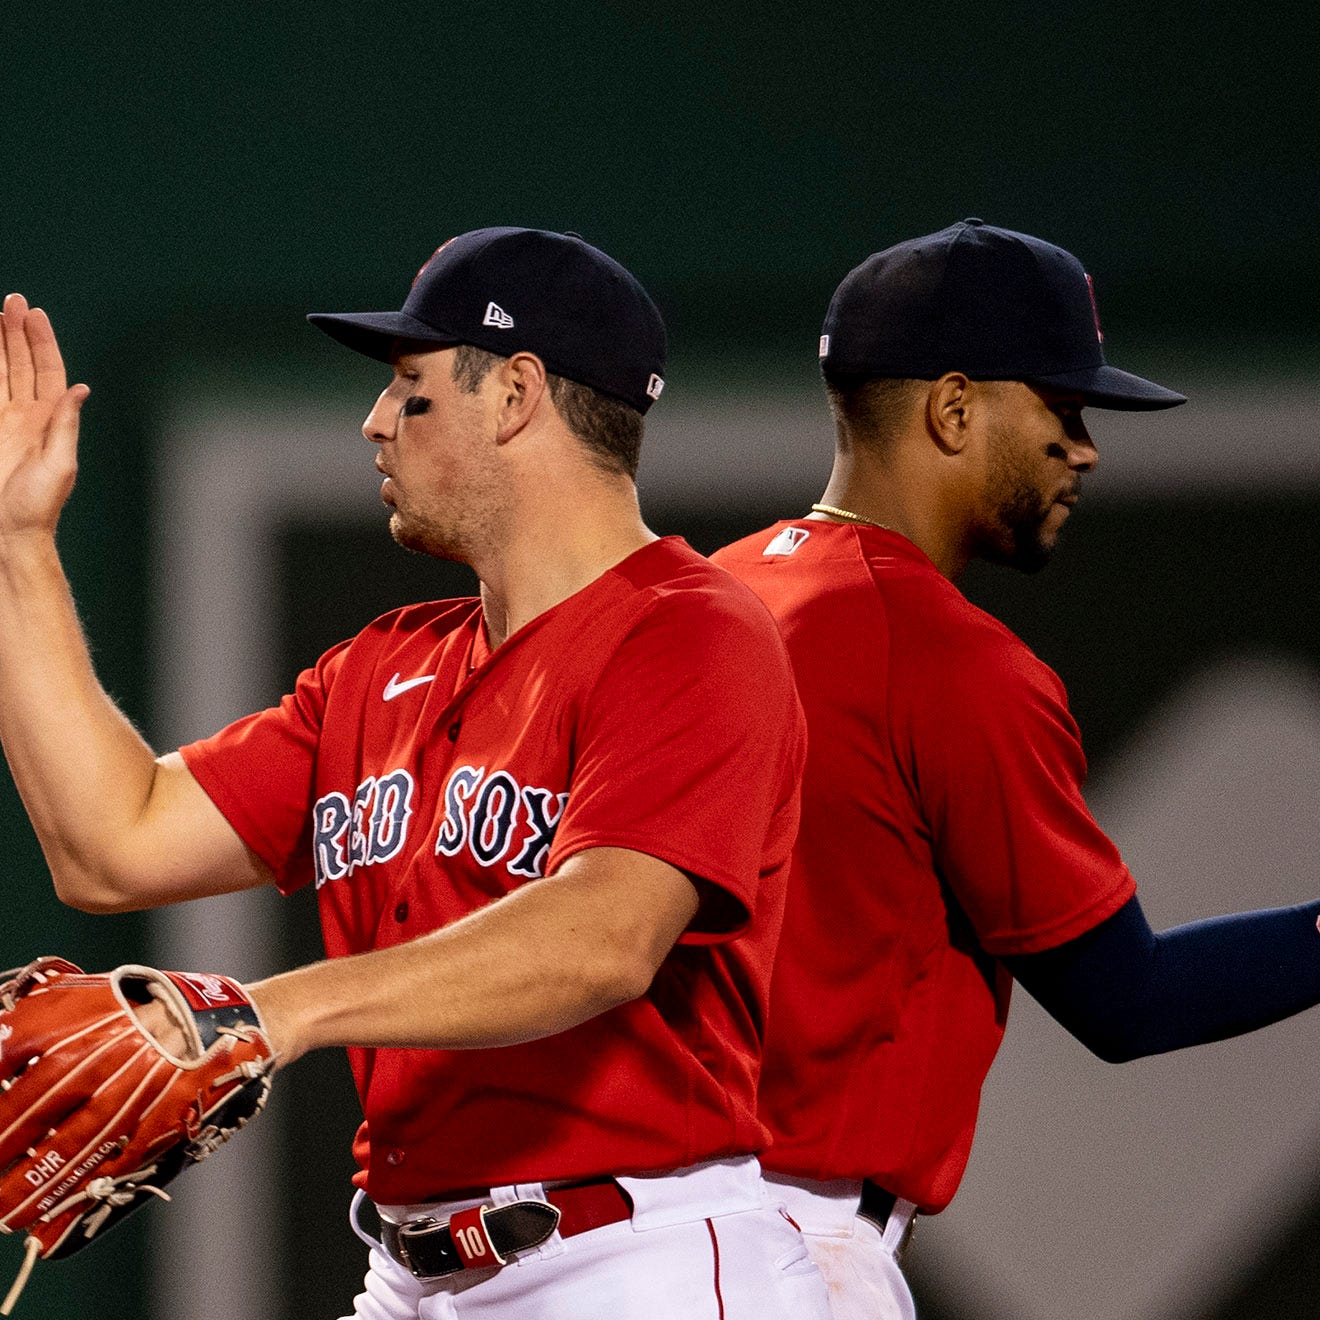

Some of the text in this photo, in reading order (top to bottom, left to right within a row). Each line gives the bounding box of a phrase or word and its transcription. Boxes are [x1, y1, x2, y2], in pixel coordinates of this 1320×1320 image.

[313, 766, 570, 889] RED SOX
[24, 1150, 66, 1187] DHR
[455, 1226, 486, 1259] 10
